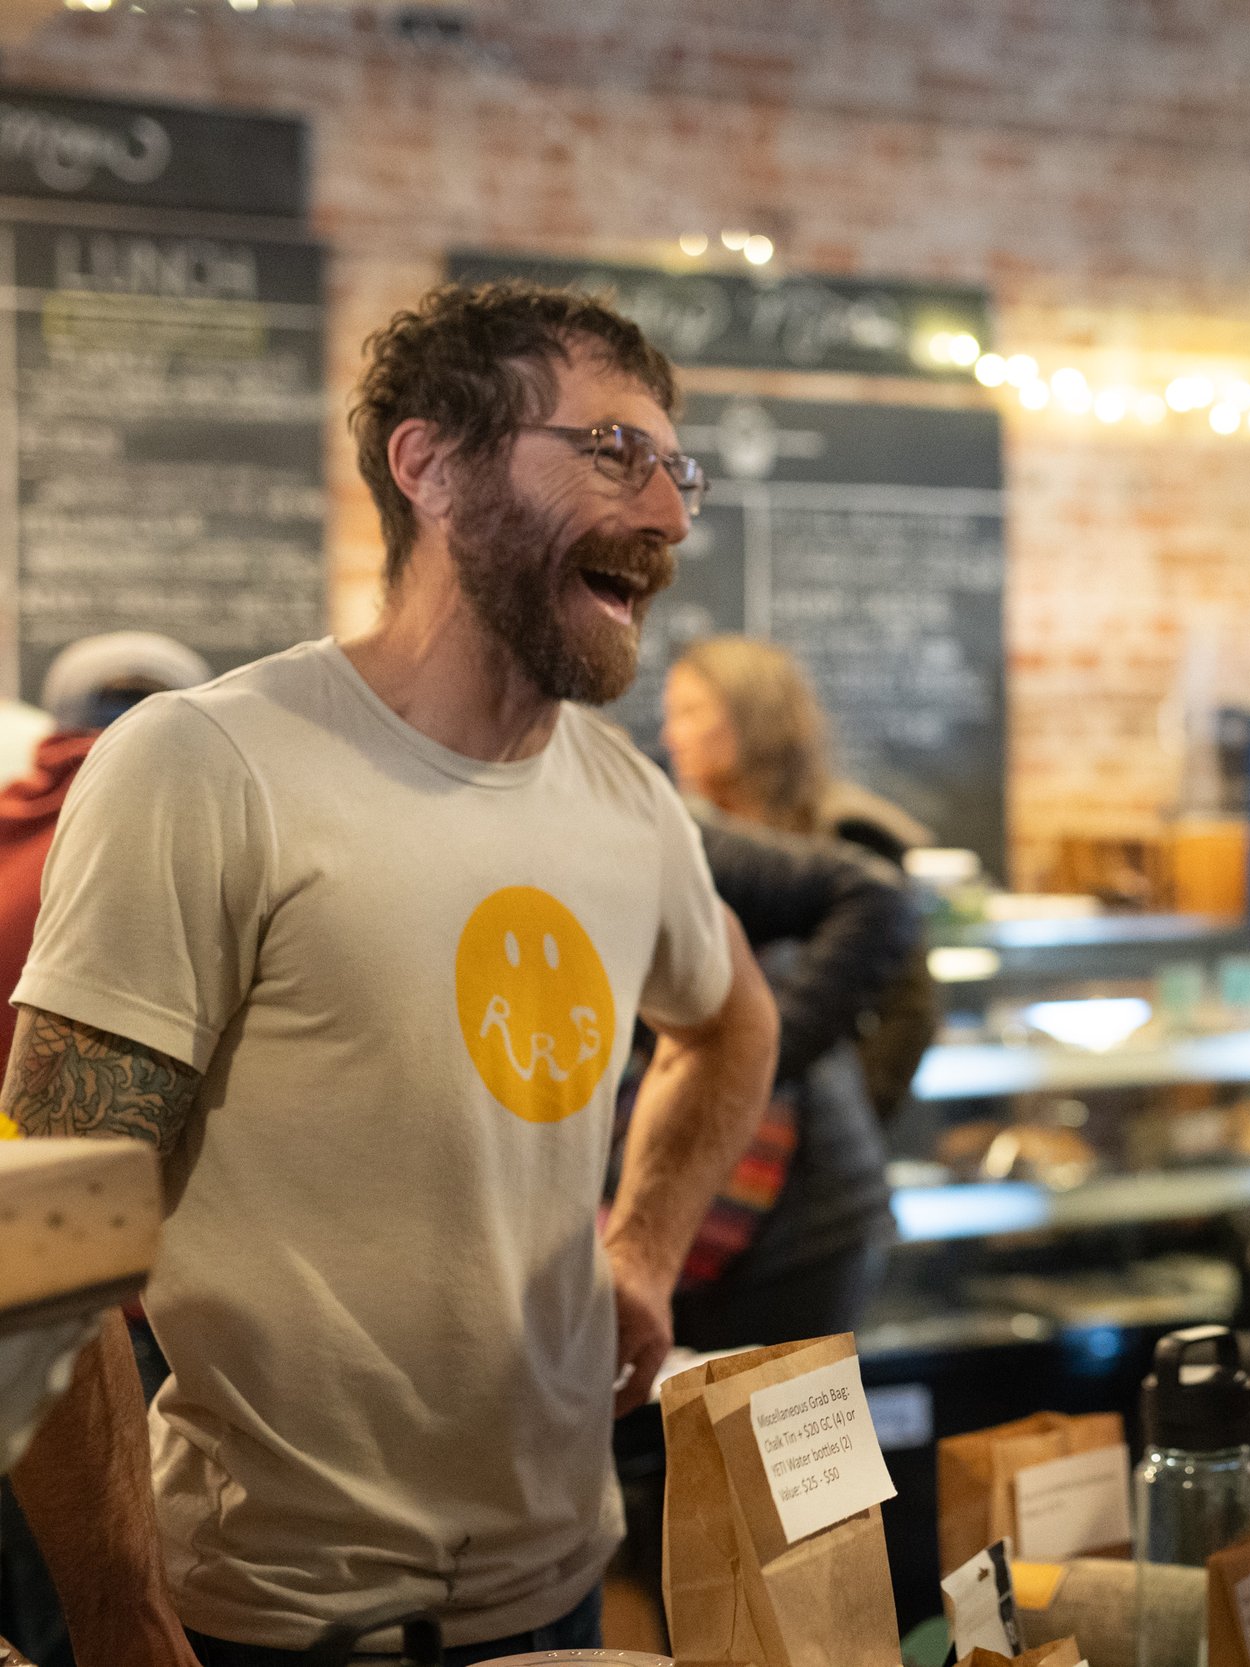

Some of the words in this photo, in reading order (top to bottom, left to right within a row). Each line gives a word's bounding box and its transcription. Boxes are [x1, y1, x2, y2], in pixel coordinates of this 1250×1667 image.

[757, 1402, 809, 1428] Miscellaneous
[808, 1391, 829, 1409] Grab
[829, 1386, 850, 1401] Bag:
[764, 1436, 783, 1454] Chalk
[783, 1431, 798, 1446] Tin
[803, 1421, 820, 1438] $20
[820, 1416, 833, 1431] GC
[832, 1410, 846, 1429] (4)
[846, 1409, 856, 1422] or
[787, 1454, 811, 1472] Water
[811, 1440, 840, 1462] bottles
[840, 1434, 853, 1453] (2)
[779, 1486, 801, 1502] Value:
[801, 1475, 818, 1493] $25
[823, 1466, 840, 1485] $50
